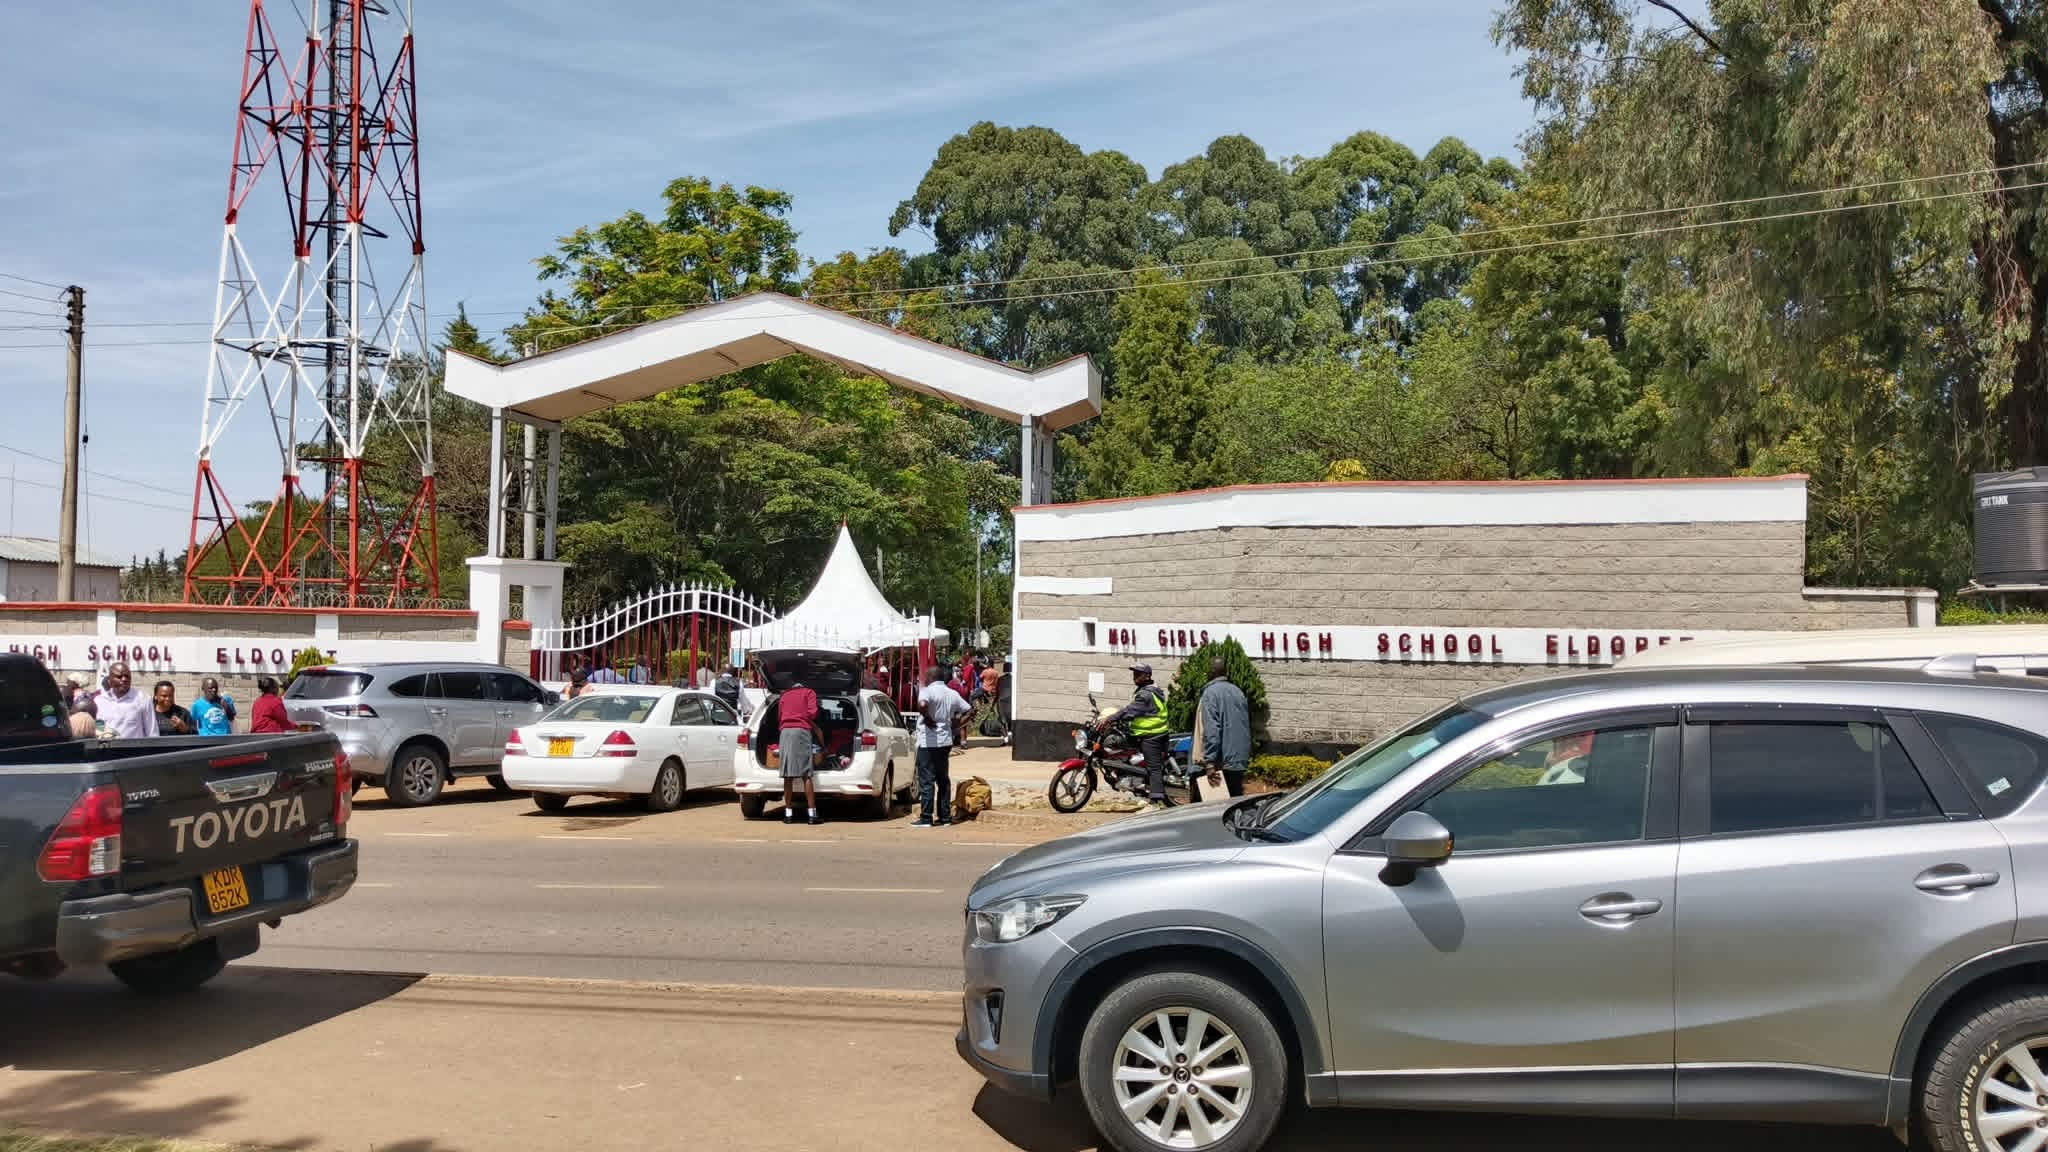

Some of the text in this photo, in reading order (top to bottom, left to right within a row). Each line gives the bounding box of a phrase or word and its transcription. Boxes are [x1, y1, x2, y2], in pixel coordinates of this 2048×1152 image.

[1108, 628, 1695, 656] MOI GIRLS HIGH SCHOOL ELDOR
[87, 645, 172, 662] SCHOOL
[216, 647, 338, 665] ELDORT
[169, 795, 307, 854] TOYOTA
[211, 887, 246, 911] 852K
[1979, 1040, 1999, 1065] A/T
